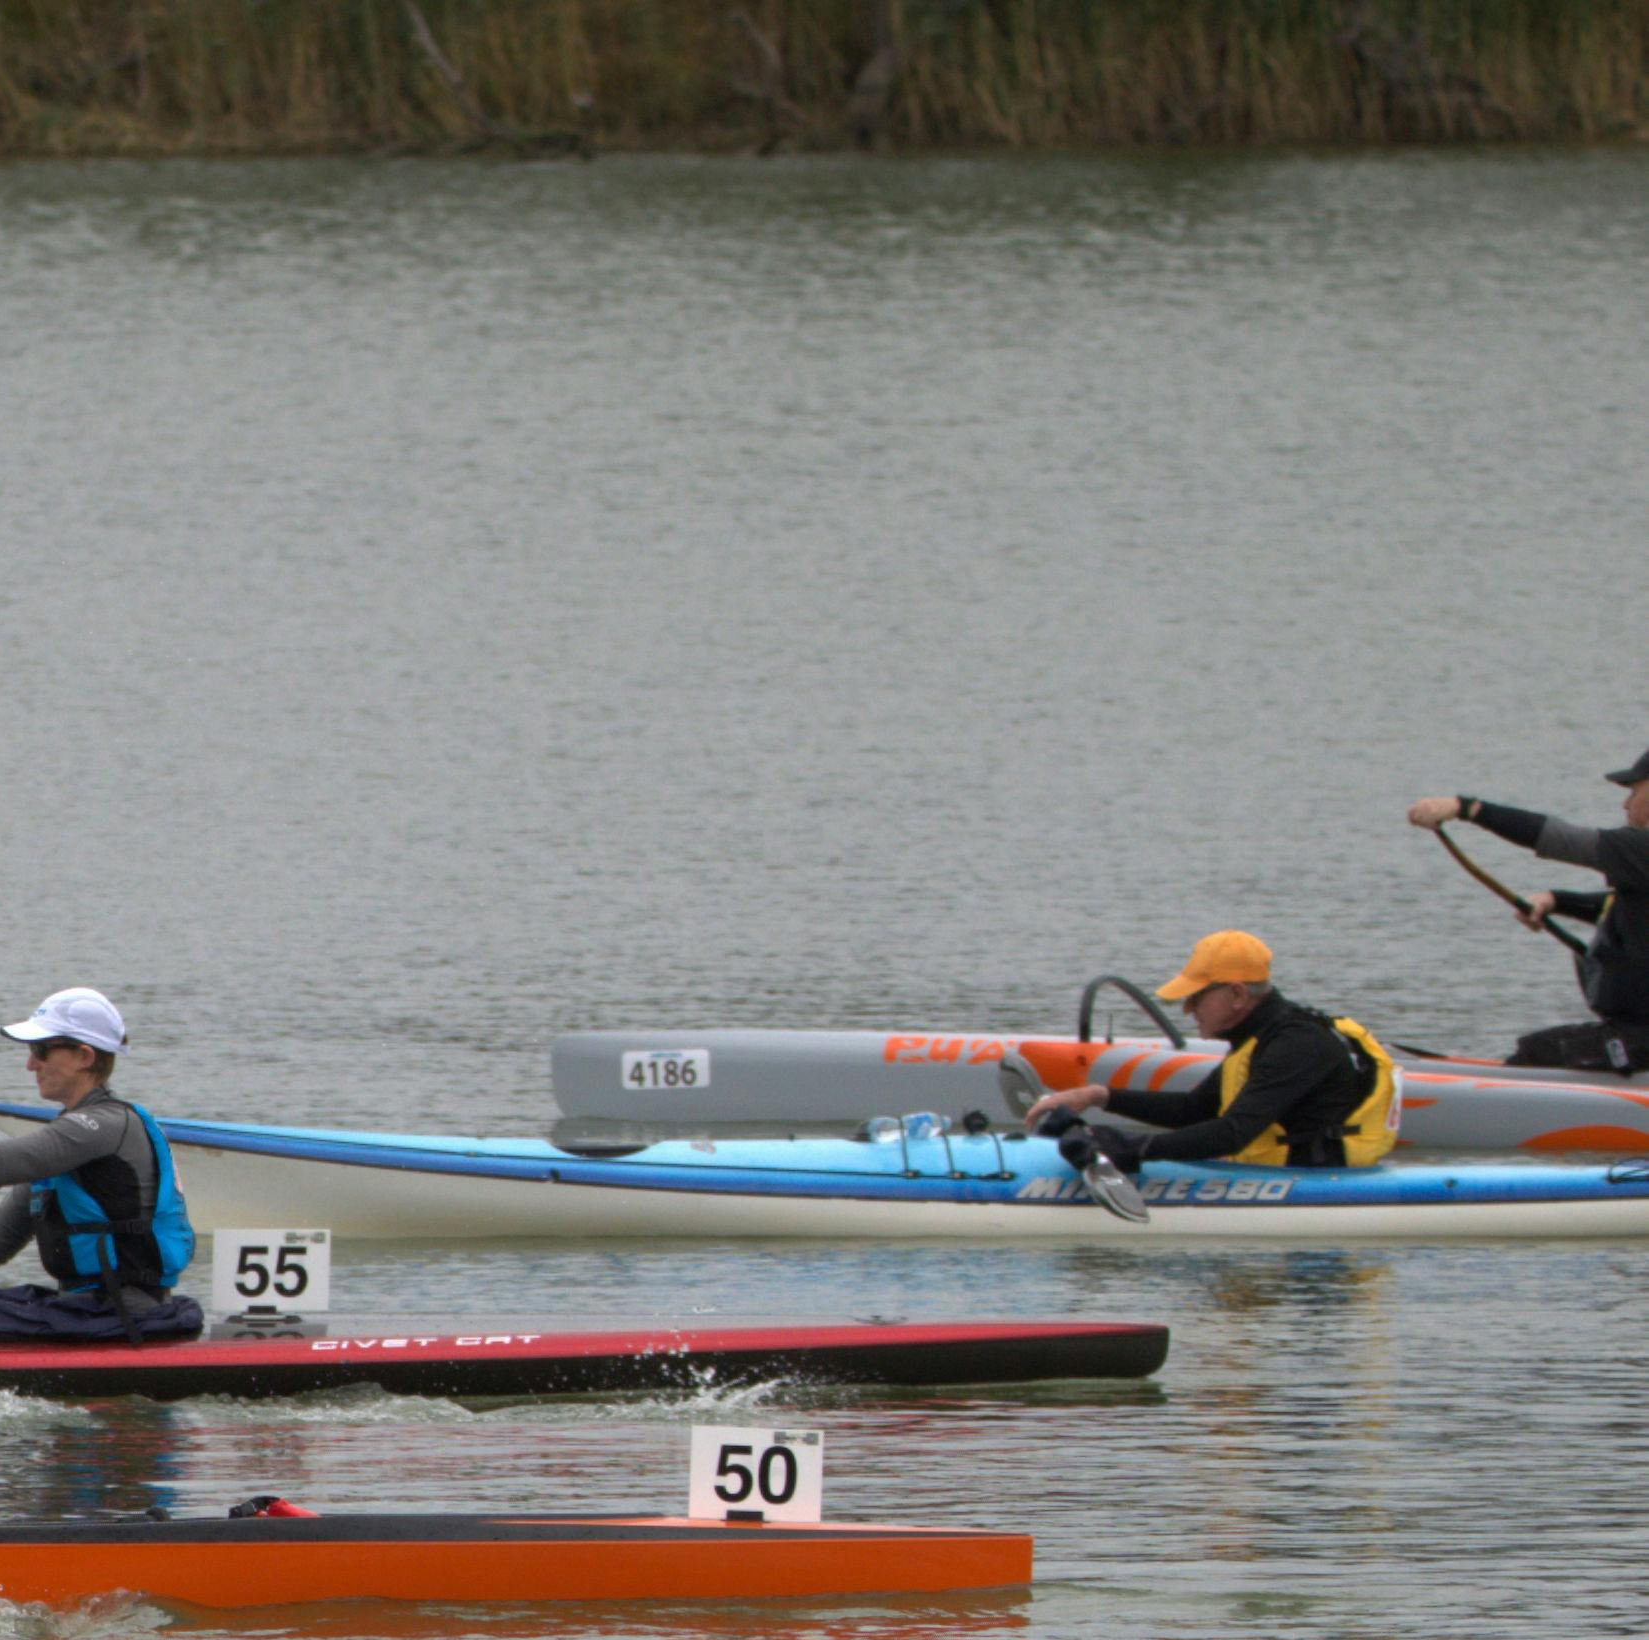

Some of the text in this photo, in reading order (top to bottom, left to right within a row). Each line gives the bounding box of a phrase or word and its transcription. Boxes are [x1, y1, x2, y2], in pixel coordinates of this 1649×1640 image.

[629, 1059, 697, 1086] 4186
[1195, 1178, 1293, 1200] 580
[234, 1245, 308, 1298] 55
[714, 1444, 797, 1505] 50
